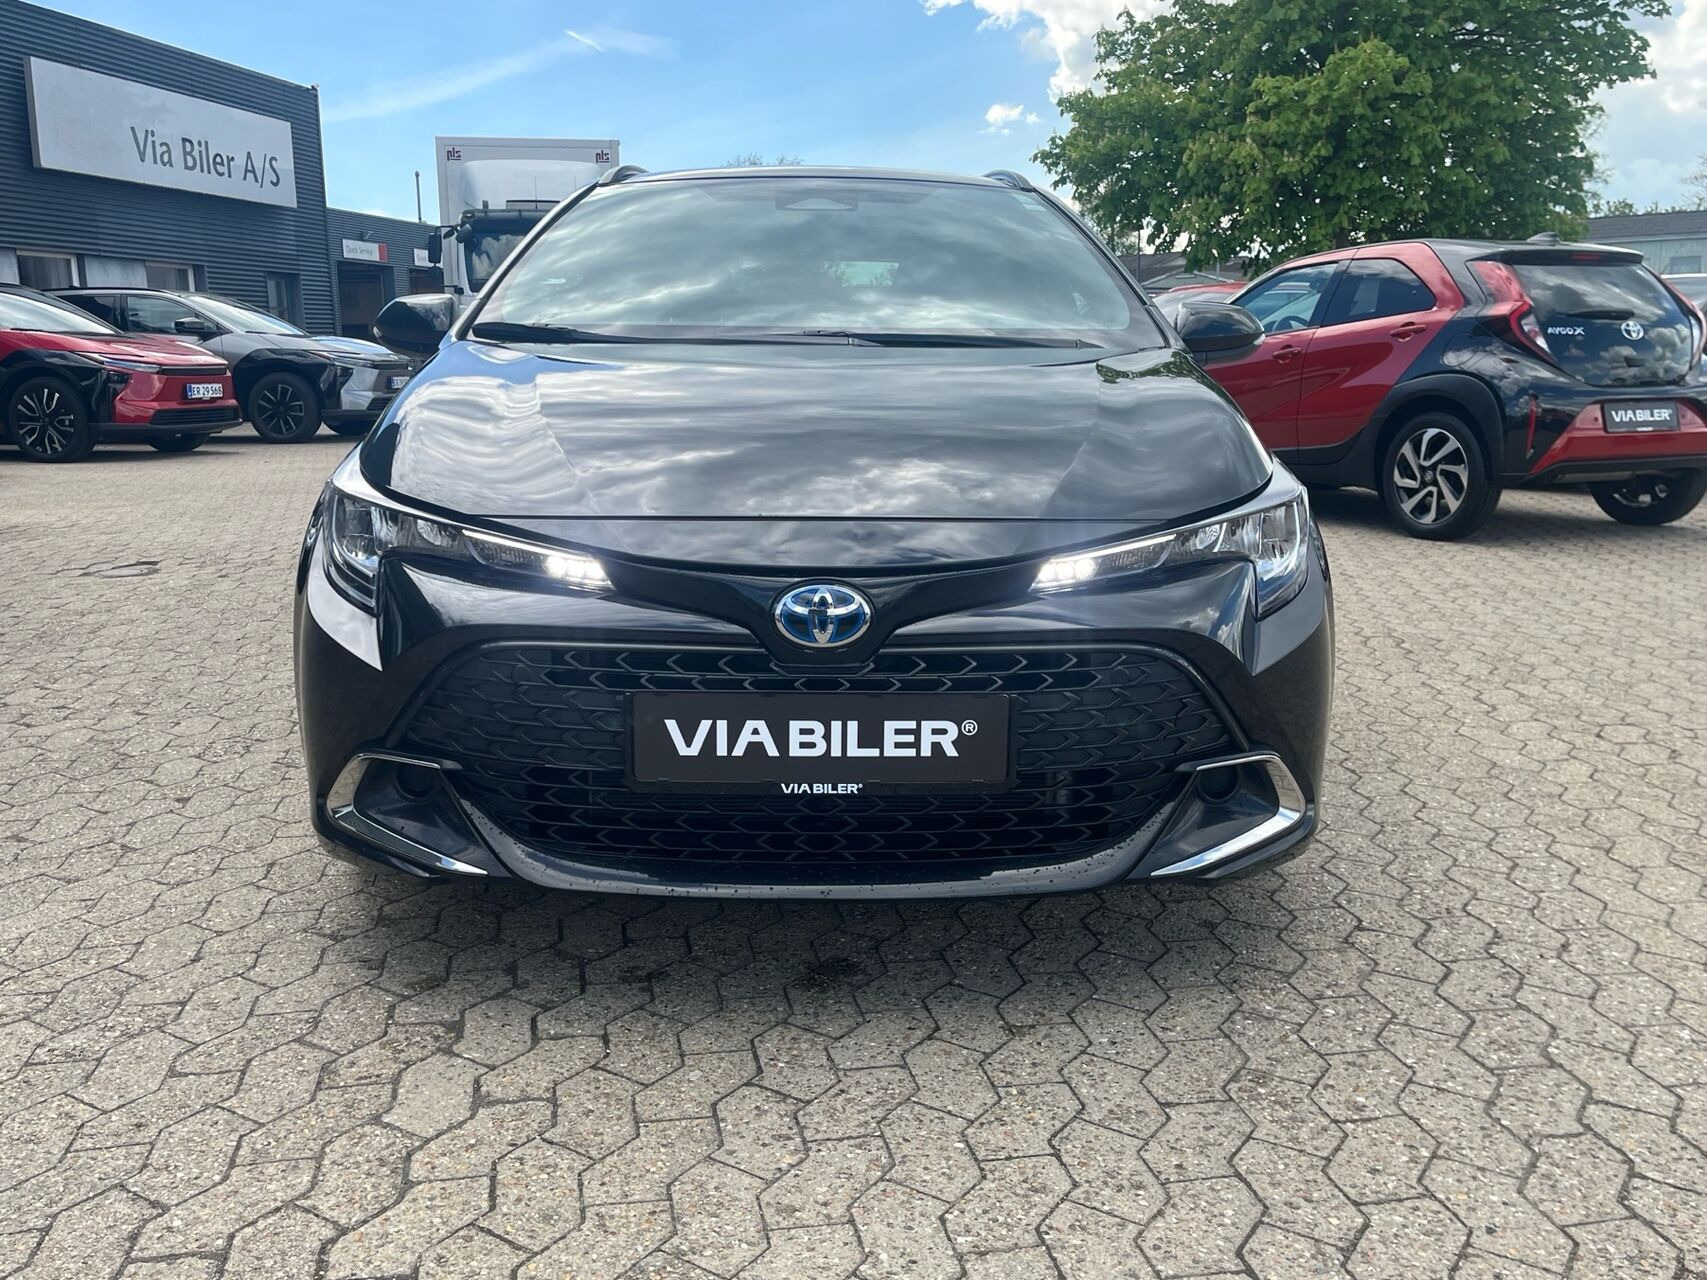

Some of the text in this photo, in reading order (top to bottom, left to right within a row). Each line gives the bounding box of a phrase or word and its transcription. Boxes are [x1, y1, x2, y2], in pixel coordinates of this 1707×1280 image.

[130, 126, 280, 188] Via Biler A/S
[664, 719, 779, 757] VIA
[781, 783, 810, 794] VIA
